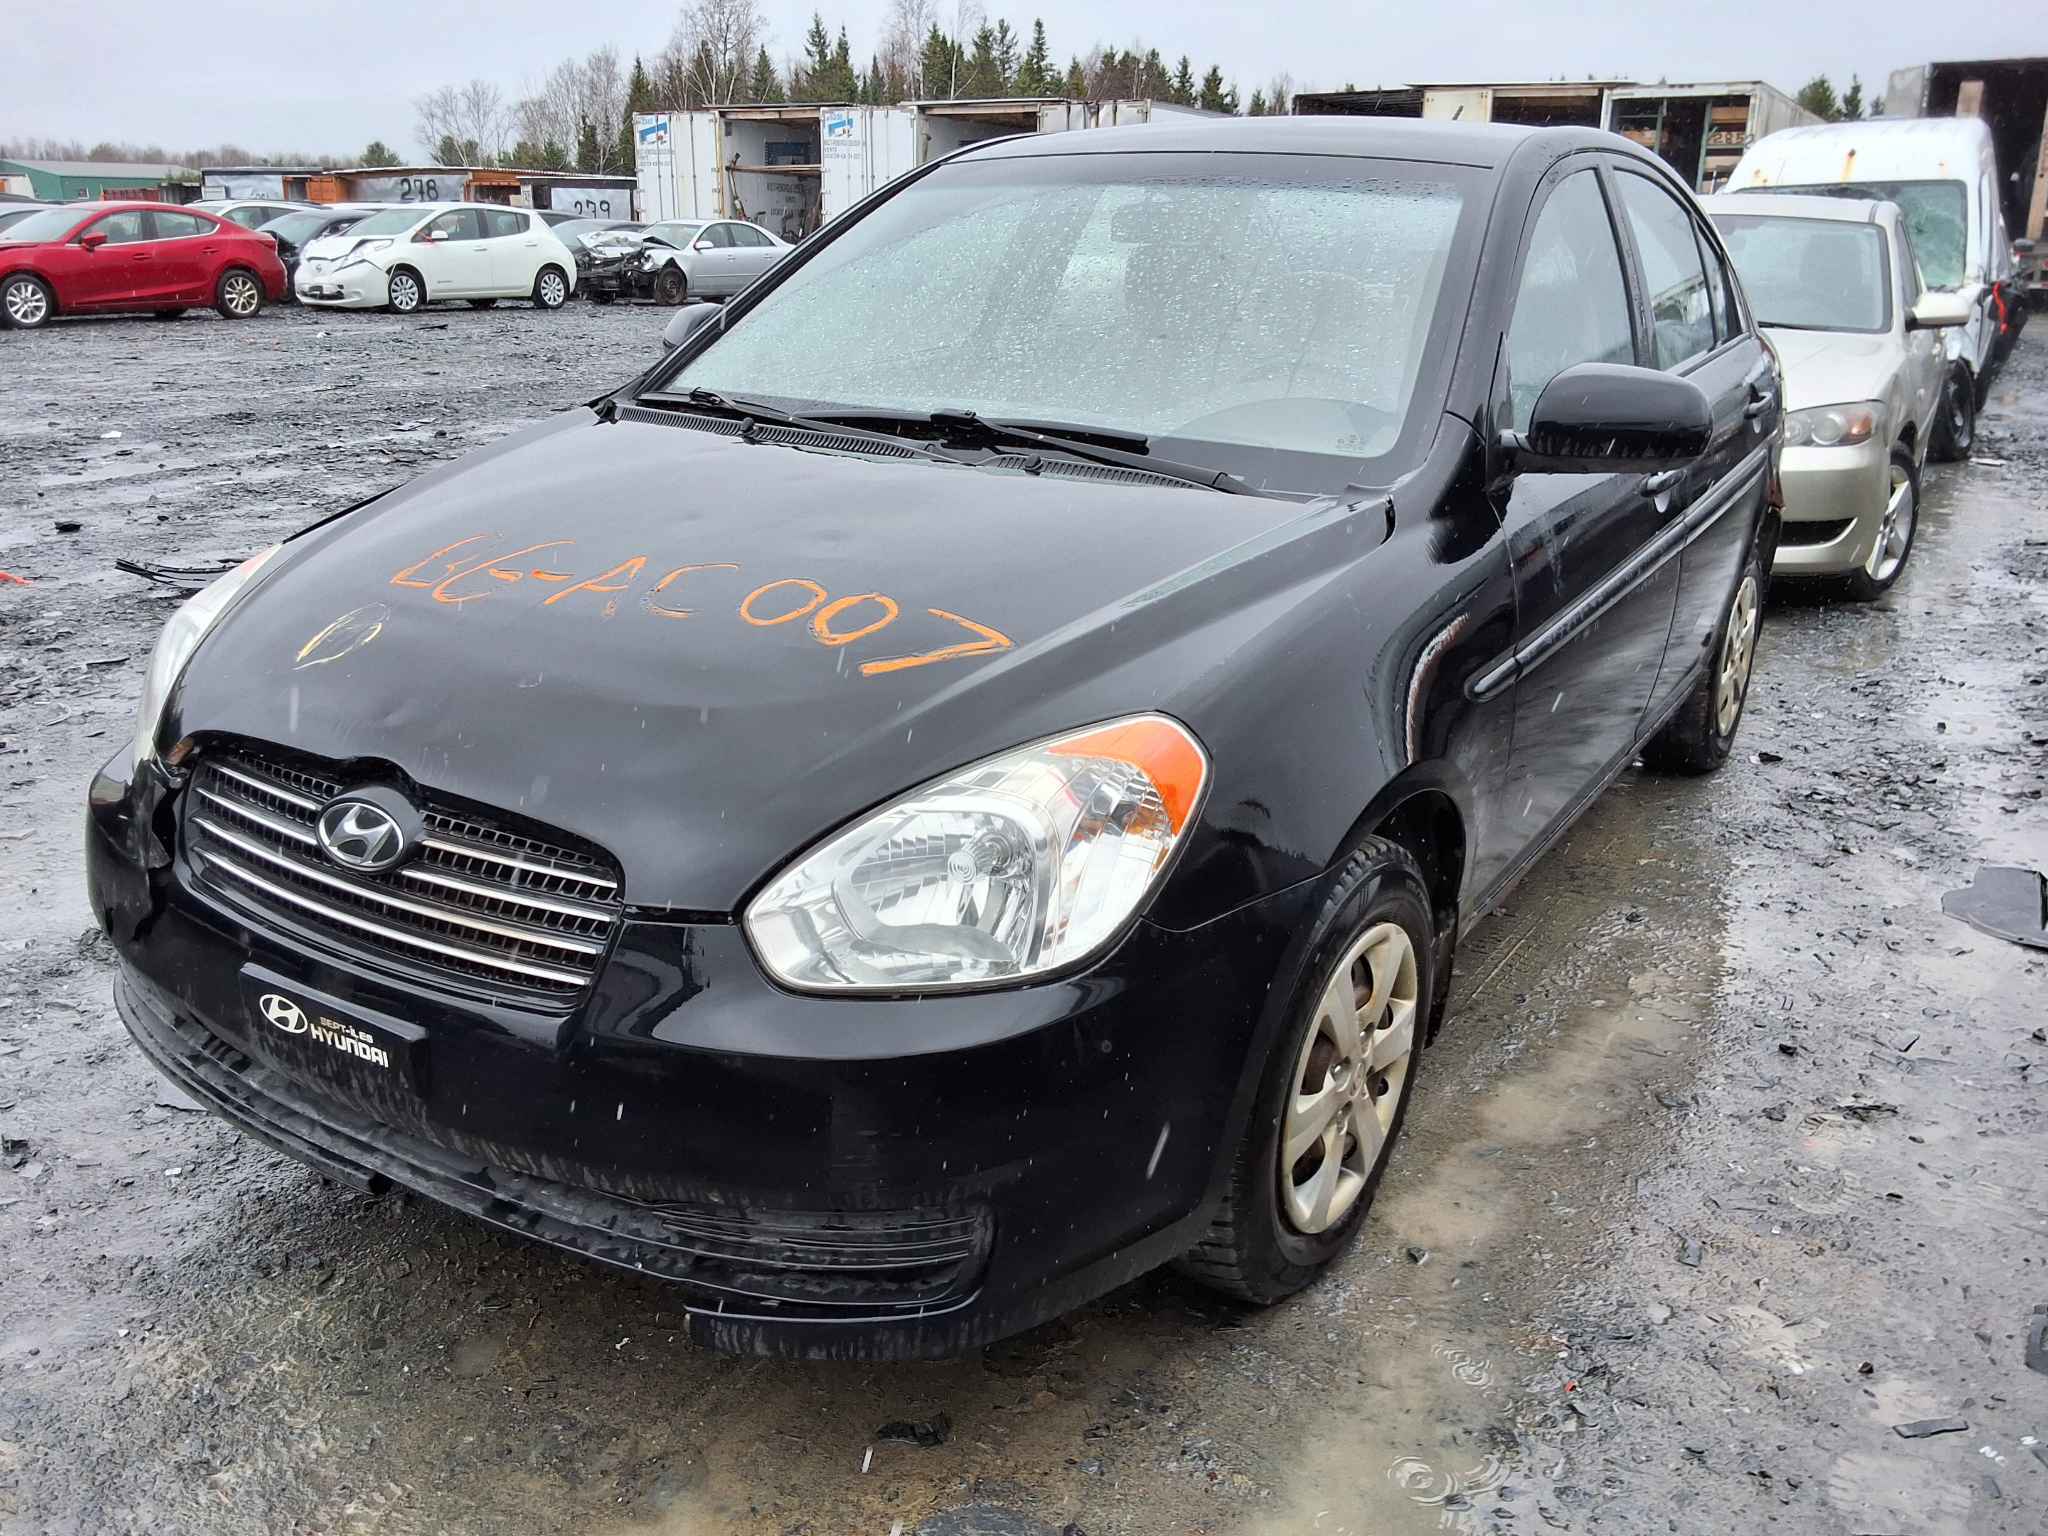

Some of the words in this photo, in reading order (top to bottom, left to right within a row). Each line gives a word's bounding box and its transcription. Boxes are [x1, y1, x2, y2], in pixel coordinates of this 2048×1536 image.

[400, 177, 439, 203] 278
[574, 199, 611, 219] 279
[310, 1023, 389, 1068] HYUNDAI
